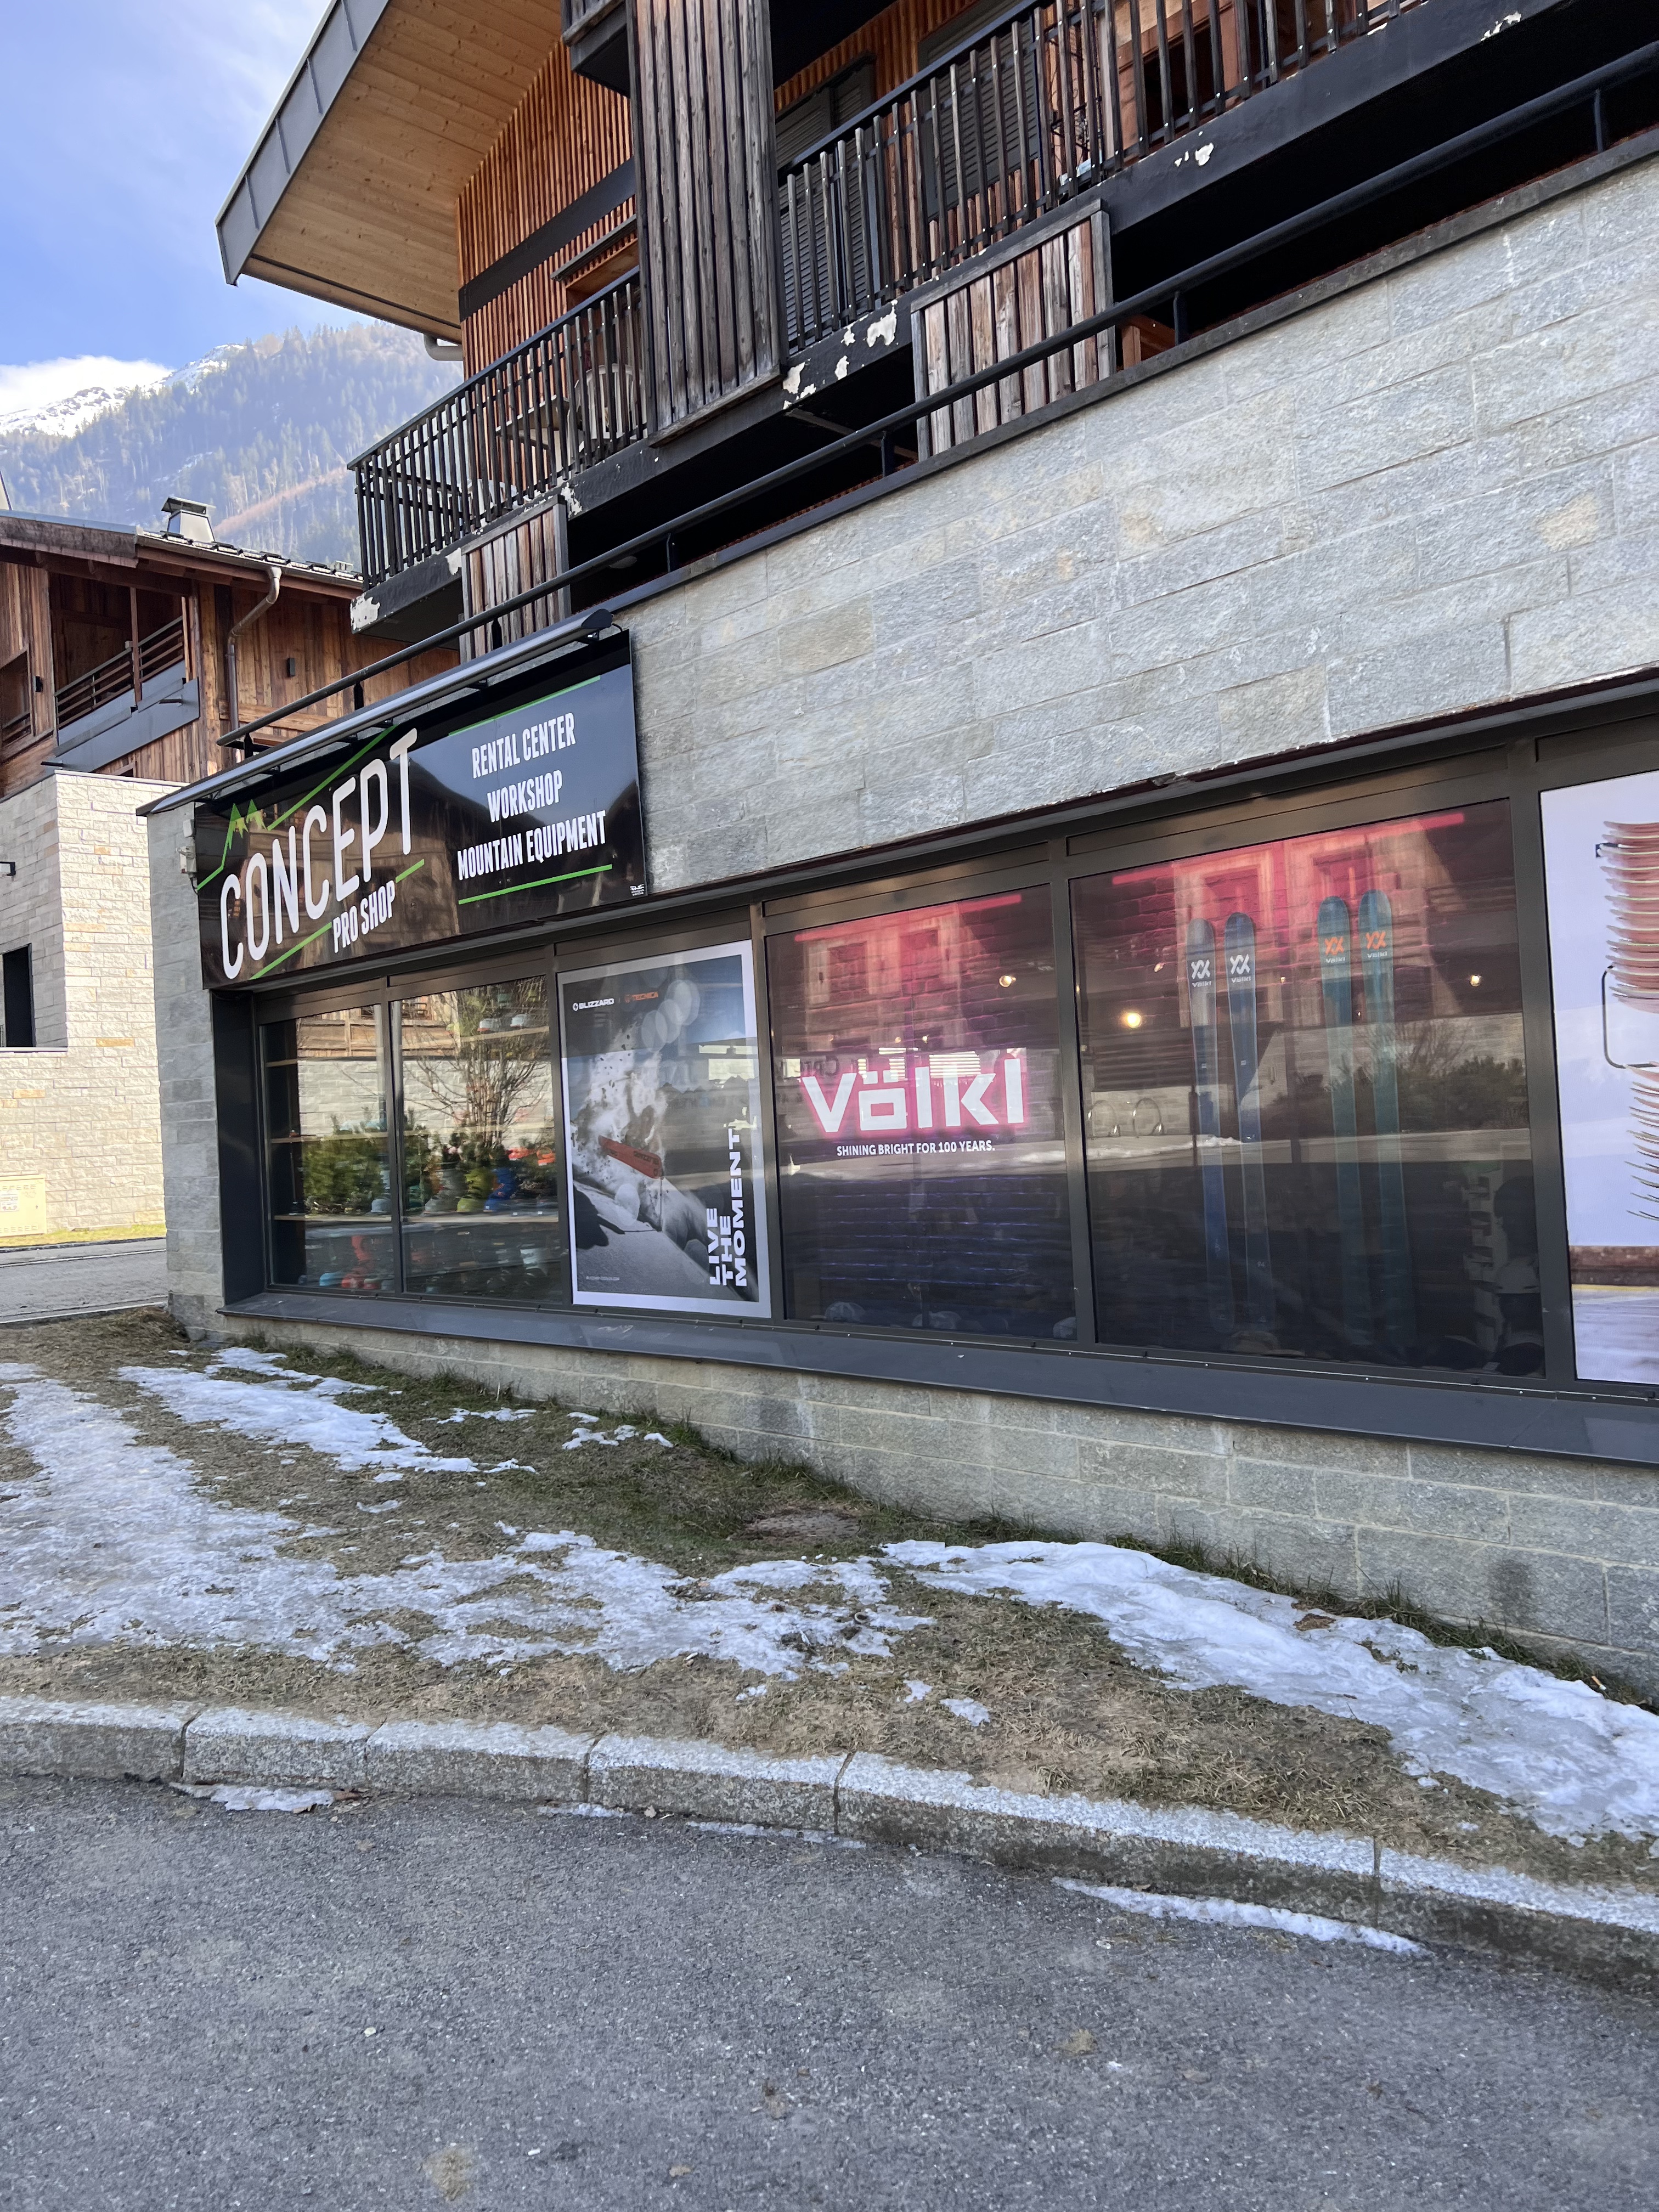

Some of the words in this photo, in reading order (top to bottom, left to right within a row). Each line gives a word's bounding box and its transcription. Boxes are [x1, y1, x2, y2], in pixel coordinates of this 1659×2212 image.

[472, 733, 521, 778] RENTAL
[522, 712, 576, 761] CENTER
[487, 770, 563, 823] WORKSHOP
[221, 727, 417, 979] CONCEPT
[457, 833, 523, 881] MOUNTAIN
[526, 810, 606, 864] EQUIPMENT
[333, 917, 358, 953] PRO
[360, 880, 396, 935] SHOP
[579, 998, 614, 1009] BLIZZARD
[801, 1058, 1024, 1133] Völkl
[837, 1144, 877, 1156] SHINING
[878, 1143, 915, 1155] BRIGHT
[916, 1142, 937, 1154] FOR
[939, 1141, 957, 1153] 100
[958, 1139, 995, 1152] YEARS.
[728, 1128, 747, 1286] MOMENT
[706, 1208, 721, 1285] LIVE
[719, 1216, 733, 1286] THE
